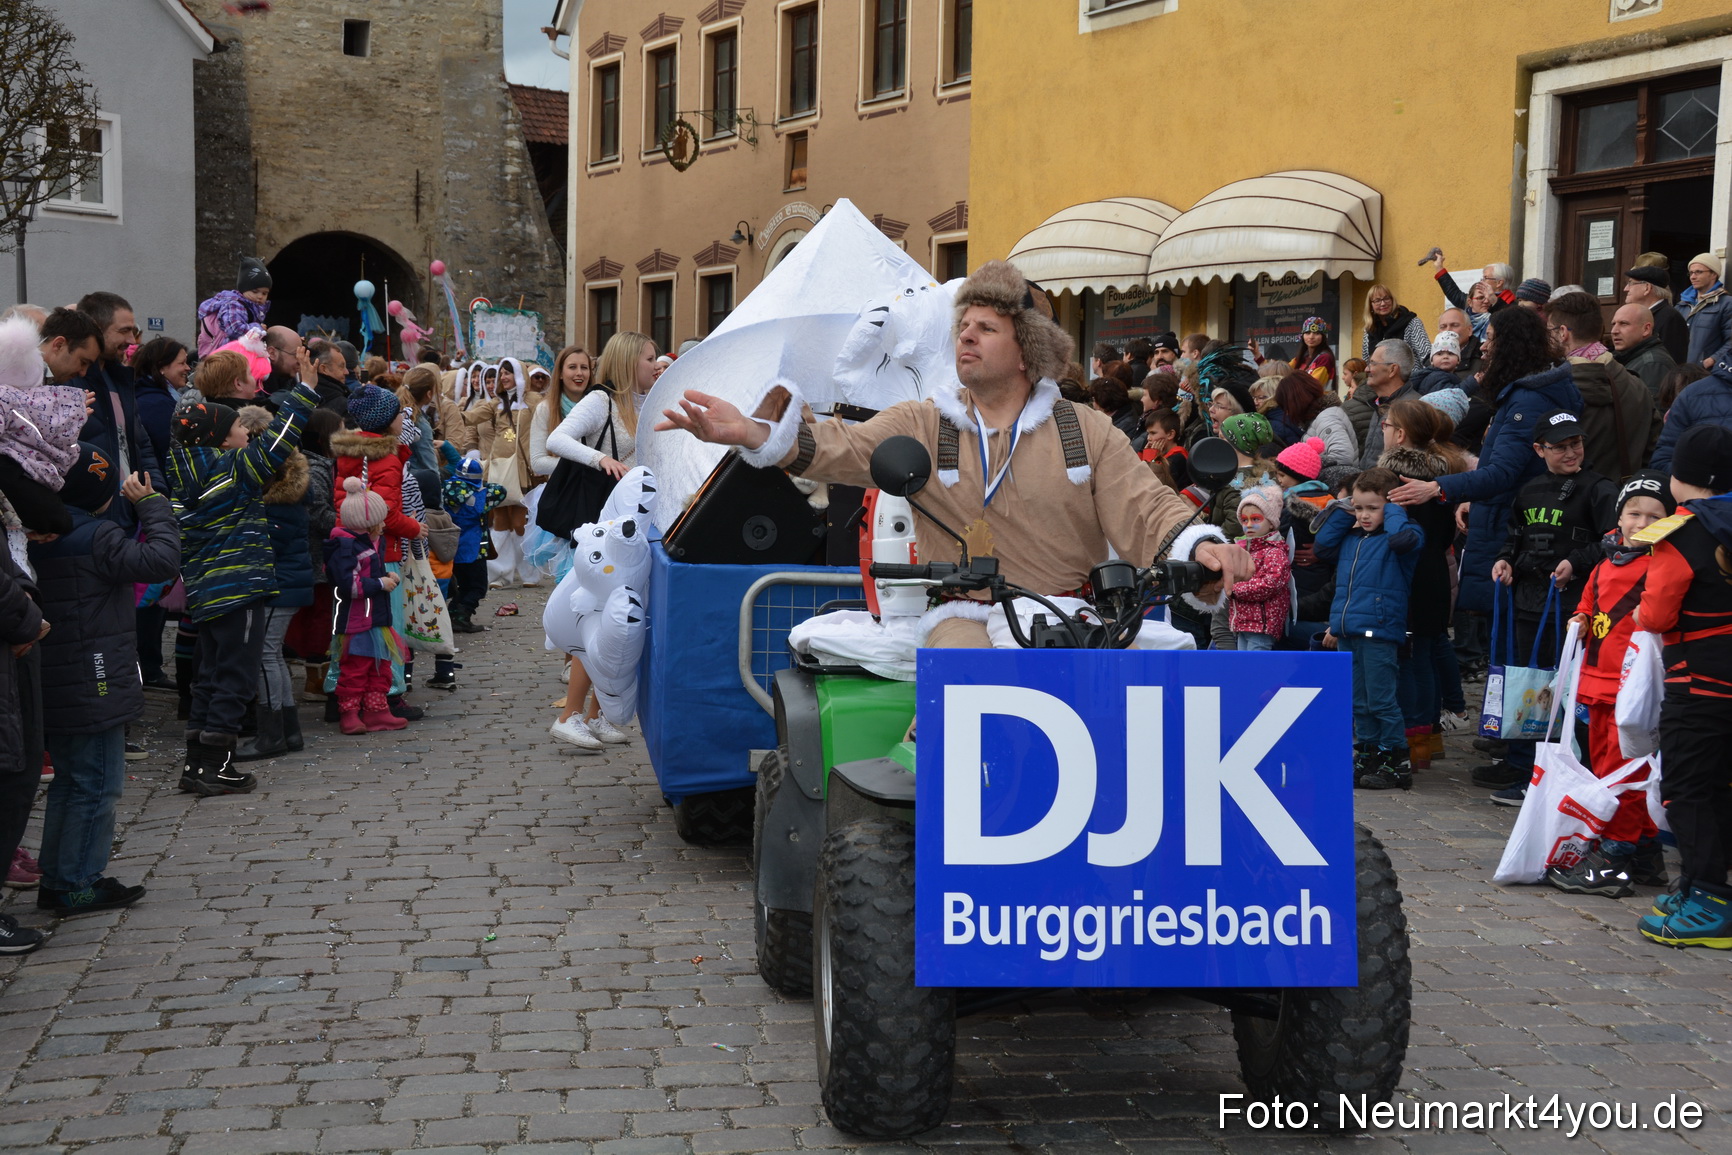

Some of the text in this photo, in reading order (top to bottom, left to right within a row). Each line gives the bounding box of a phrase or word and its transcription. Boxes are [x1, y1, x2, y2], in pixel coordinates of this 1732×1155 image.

[88, 451, 109, 481] N
[93, 652, 106, 679] DIVSN
[943, 684, 1330, 868] DJK
[943, 888, 1332, 961] Burggriesbach
